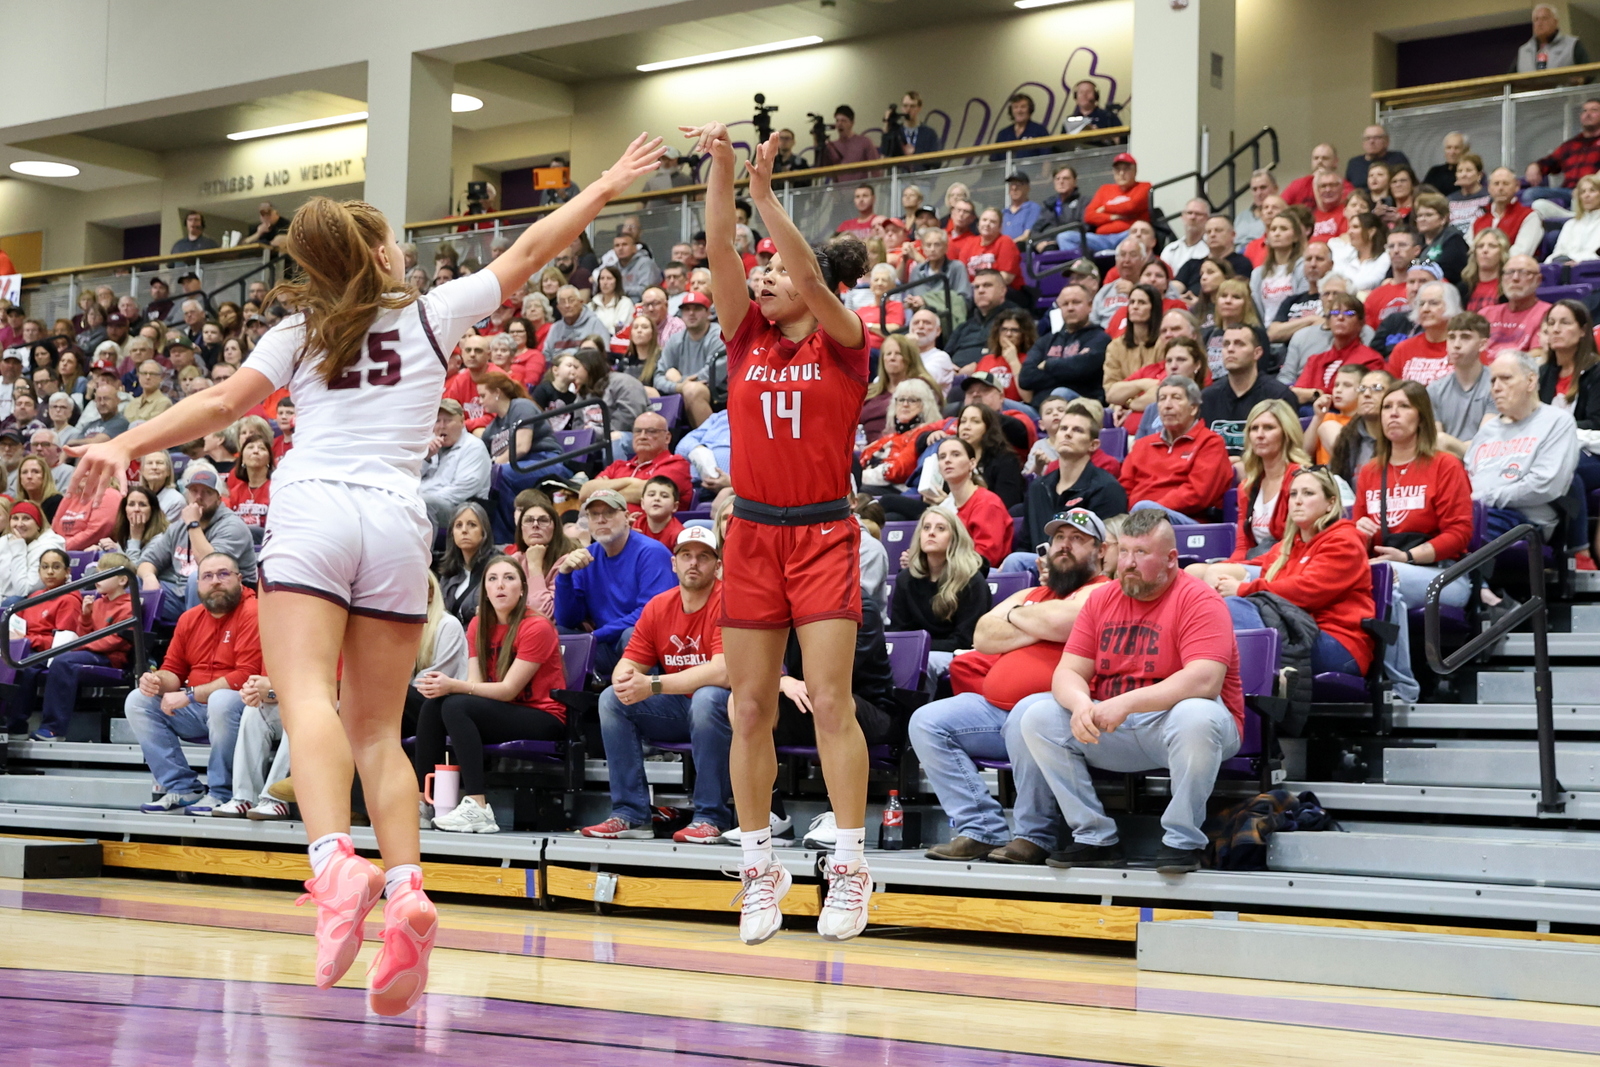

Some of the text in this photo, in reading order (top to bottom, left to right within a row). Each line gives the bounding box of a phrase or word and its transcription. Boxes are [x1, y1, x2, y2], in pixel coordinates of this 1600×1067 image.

[264, 169, 290, 188] AND
[300, 160, 352, 182] WEIGHT
[327, 328, 401, 390] 25
[759, 390, 802, 440] 14
[1501, 436, 1539, 457] STATE
[1365, 484, 1427, 502] BELEVUE
[1191, 536, 1202, 545] 41
[1101, 626, 1159, 655] STATE
[1101, 658, 1155, 673] 20 25
